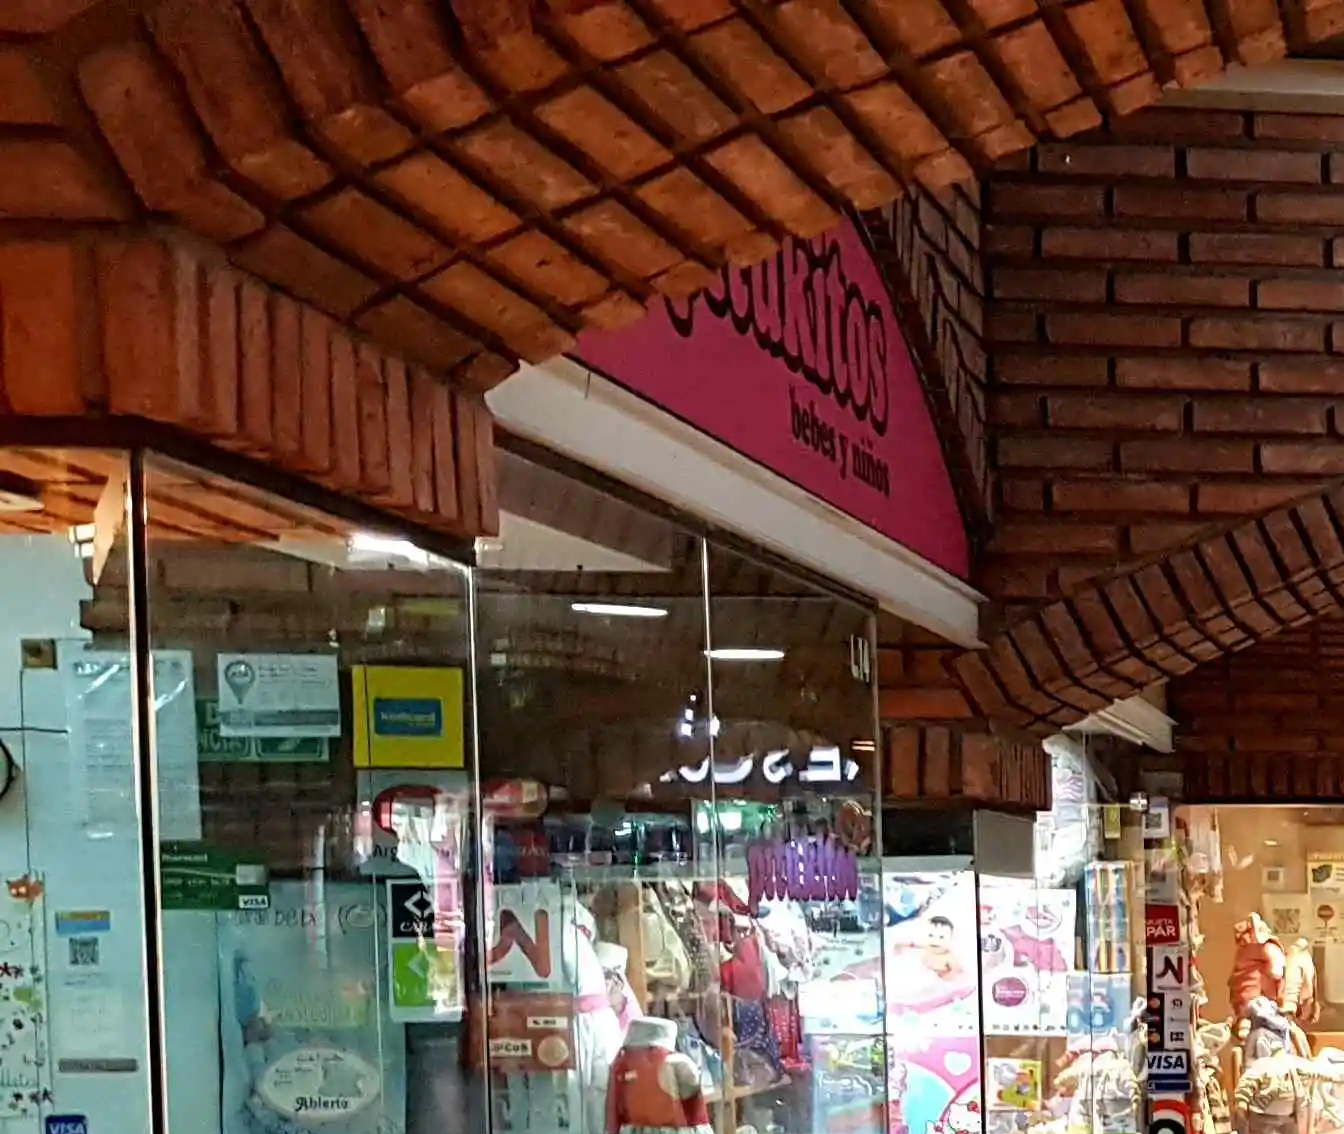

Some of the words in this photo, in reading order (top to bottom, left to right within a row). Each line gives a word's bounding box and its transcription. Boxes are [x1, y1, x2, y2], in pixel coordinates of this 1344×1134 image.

[838, 432, 850, 480] y
[242, 897, 267, 907] VISA
[1147, 1055, 1185, 1071] VISA
[295, 1096, 350, 1112] Abierto
